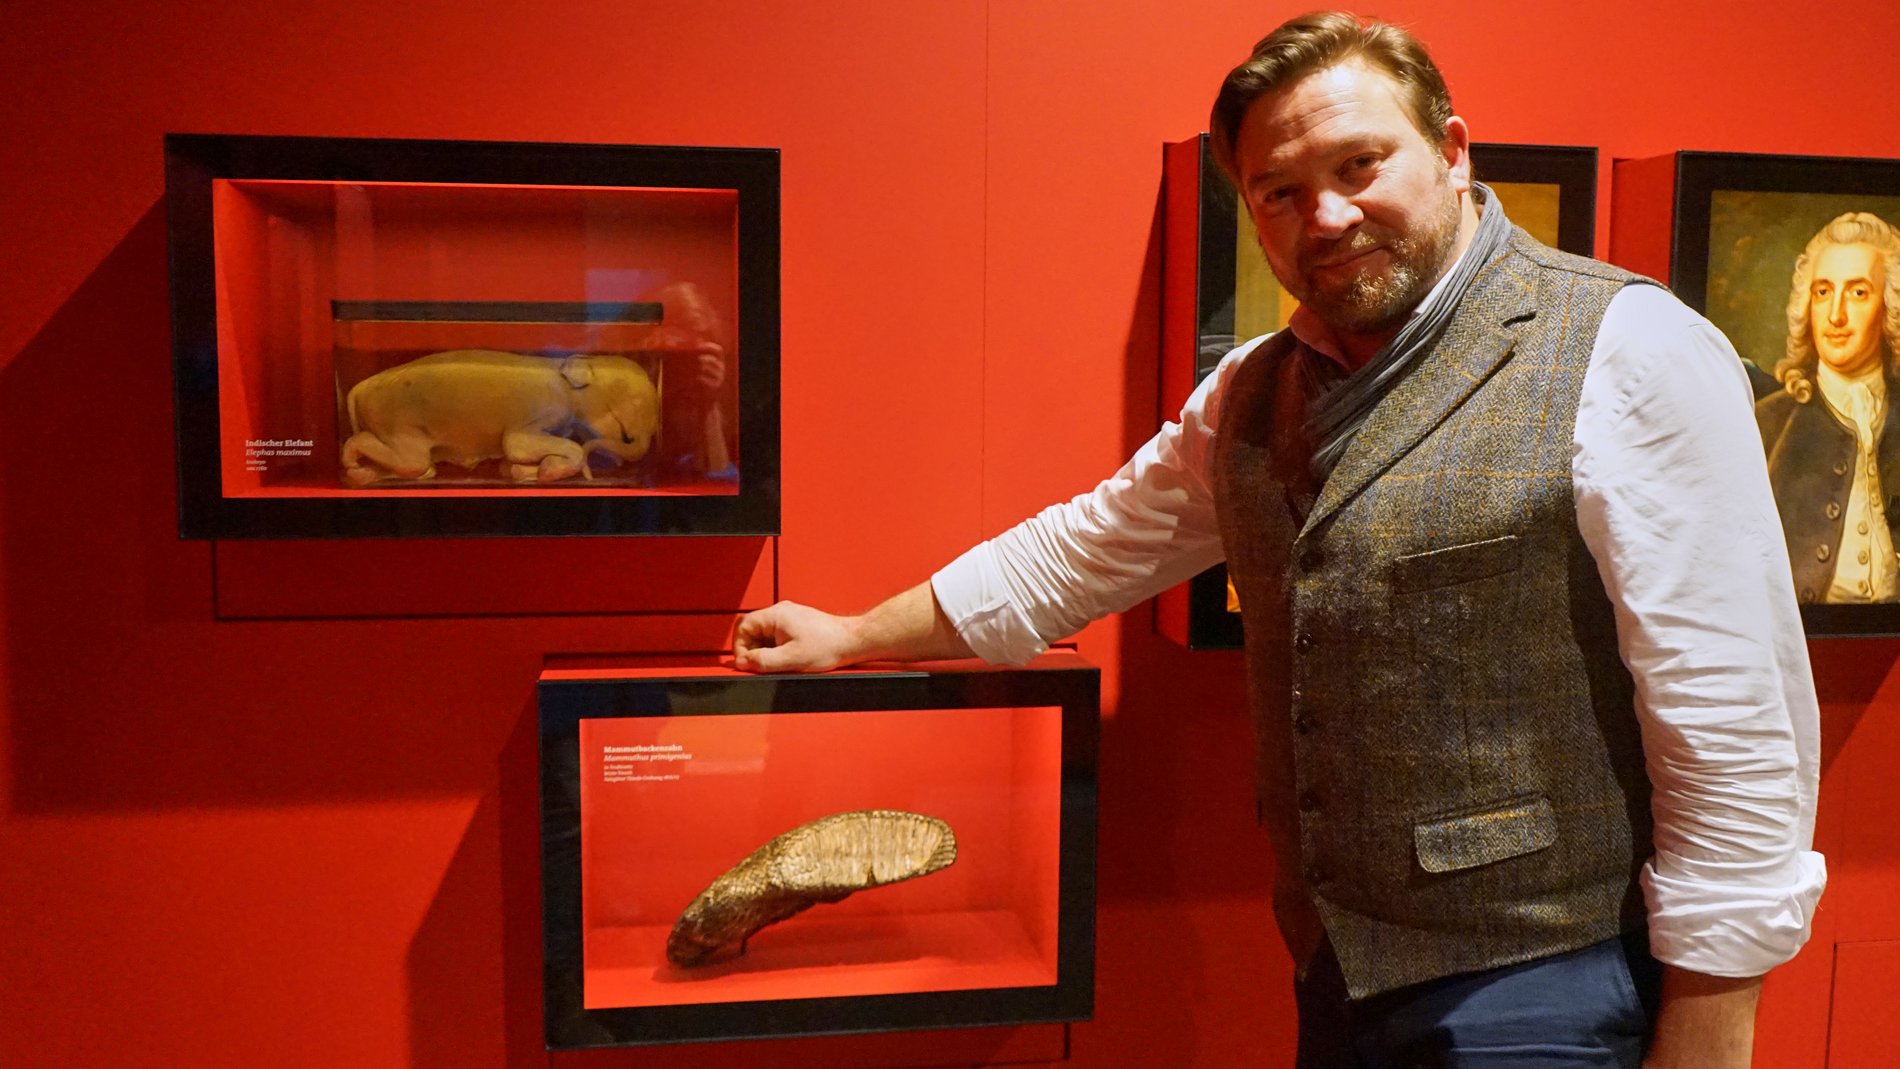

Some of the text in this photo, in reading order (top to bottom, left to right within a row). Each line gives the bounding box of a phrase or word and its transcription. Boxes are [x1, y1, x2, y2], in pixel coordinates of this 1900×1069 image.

[246, 449, 275, 457] Elephas
[603, 753, 692, 762] Mammuthus primigenius
